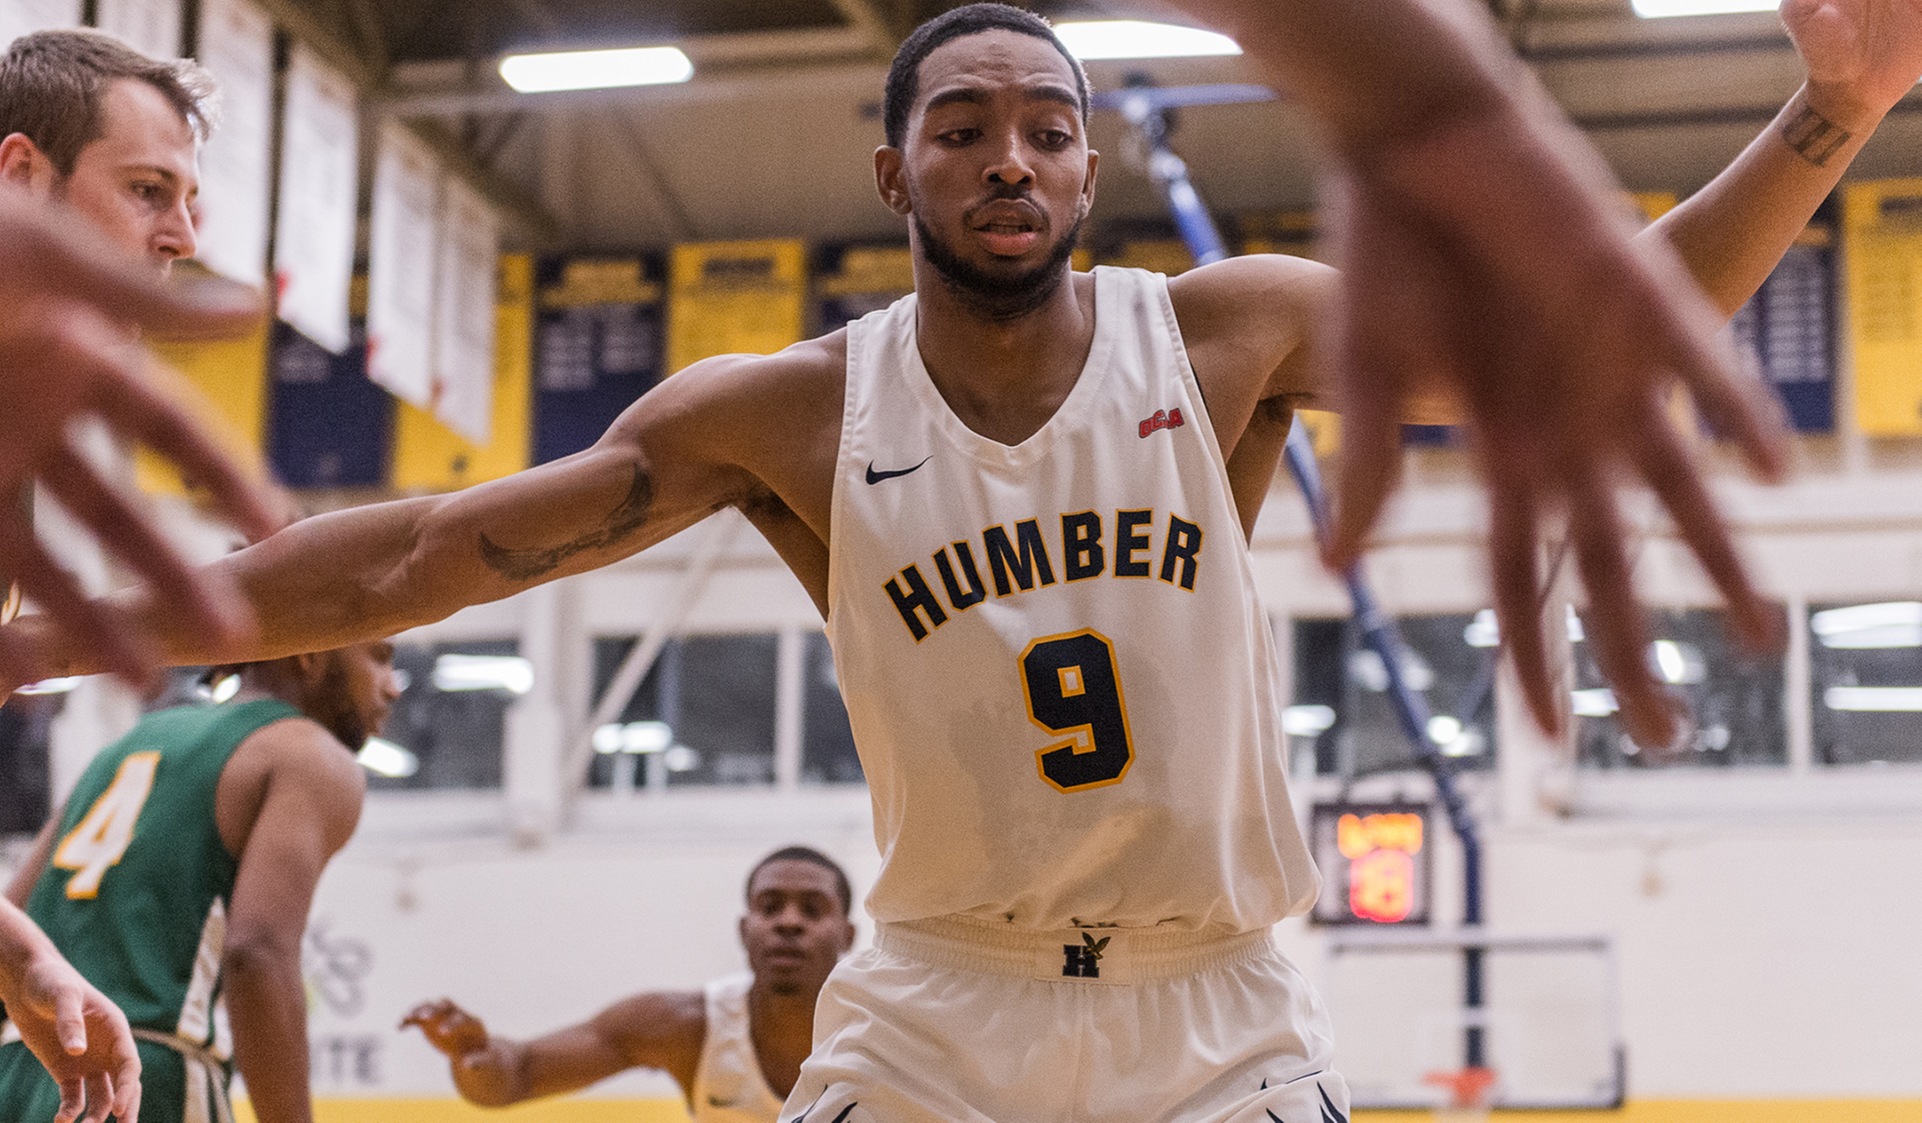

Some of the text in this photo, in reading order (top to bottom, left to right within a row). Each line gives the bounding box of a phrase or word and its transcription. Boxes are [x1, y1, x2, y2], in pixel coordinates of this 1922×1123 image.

[1138, 407, 1185, 439] OCA
[881, 508, 1204, 645] HUMBER
[1017, 626, 1136, 794] 9
[53, 751, 163, 899] 4
